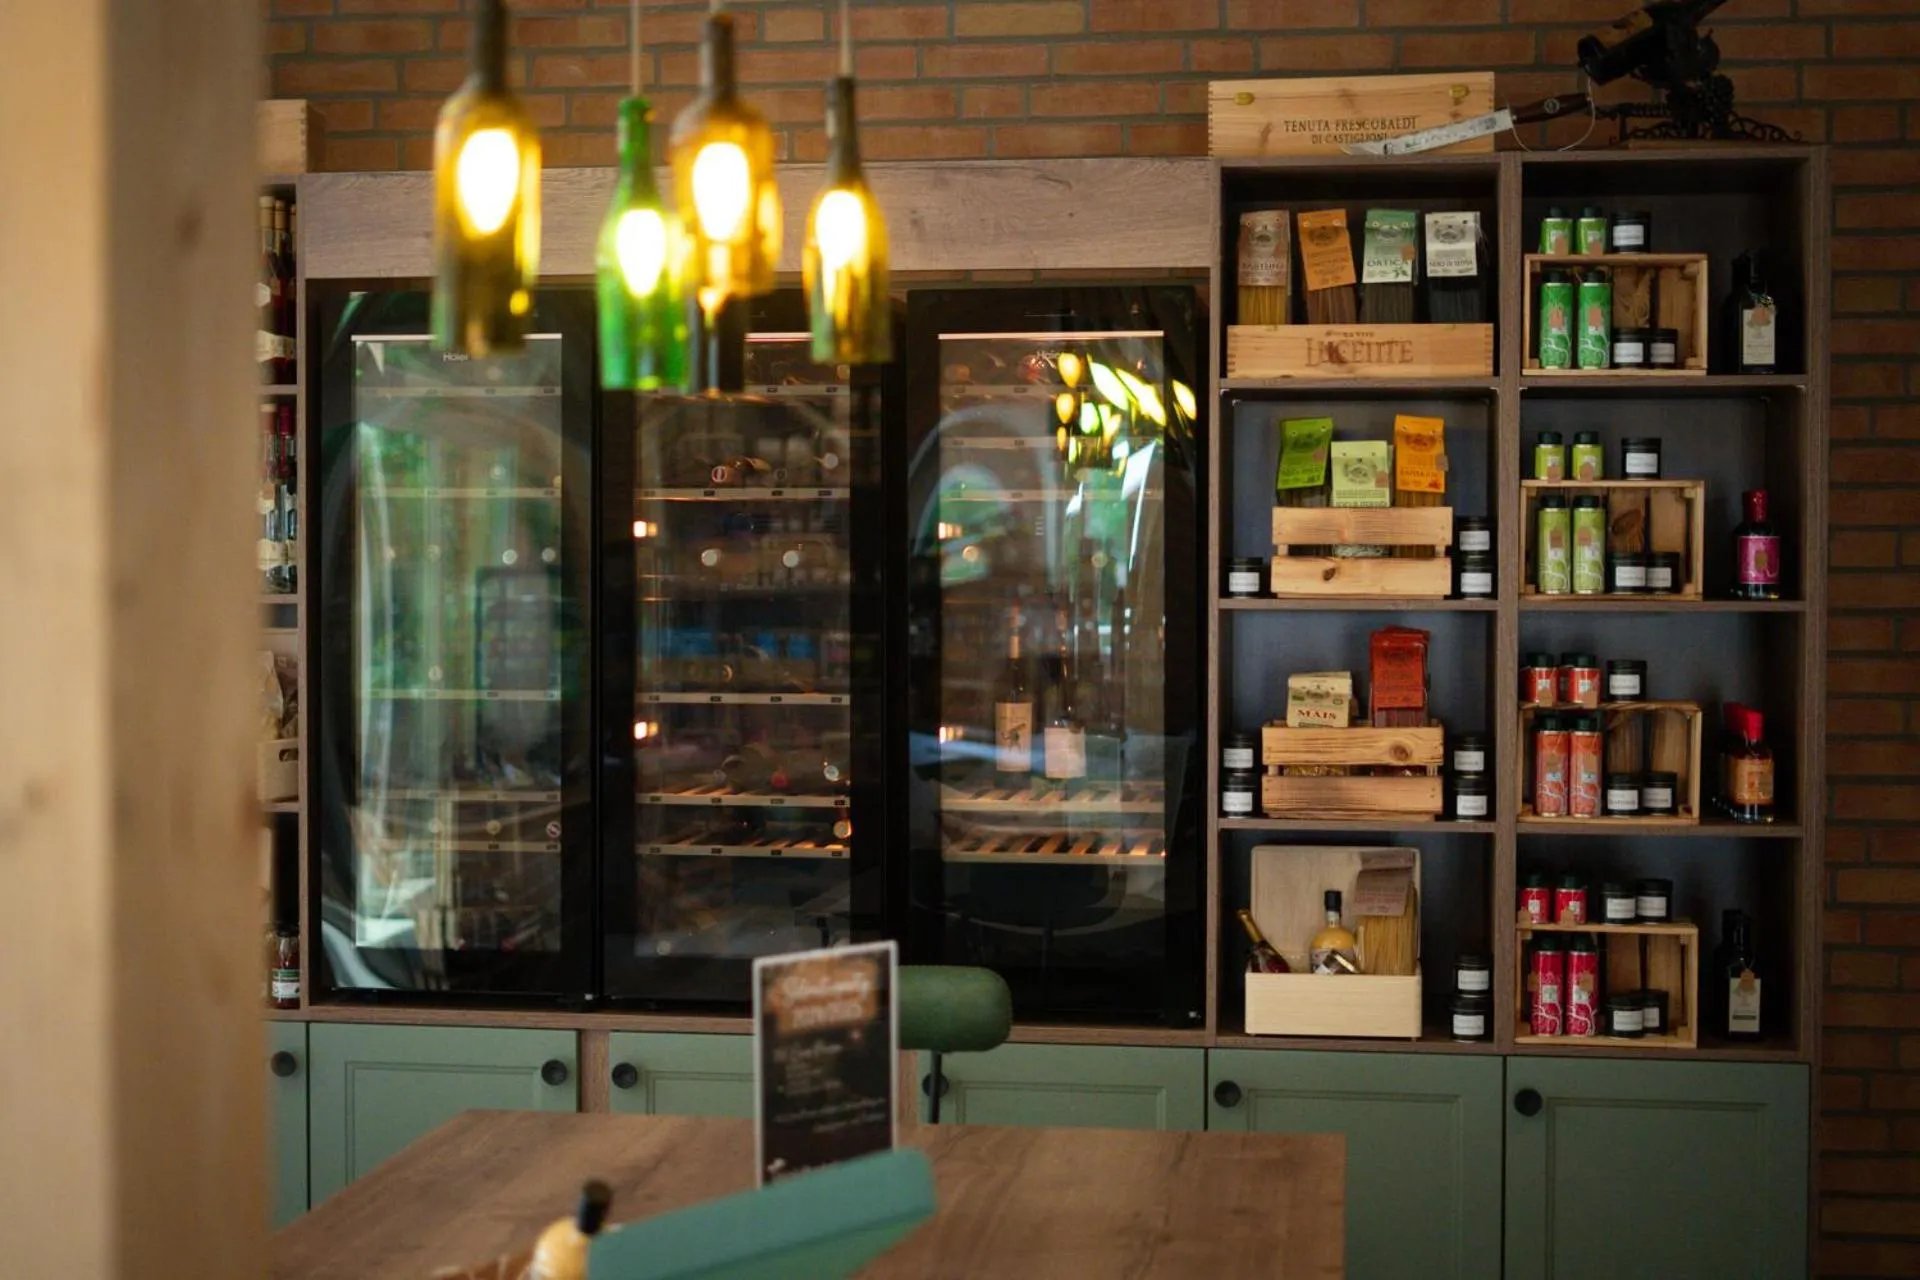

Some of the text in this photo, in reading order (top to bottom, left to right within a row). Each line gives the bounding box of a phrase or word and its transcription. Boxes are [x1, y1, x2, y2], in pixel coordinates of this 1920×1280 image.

[1284, 116, 1417, 132] TENUTA FRESCOBALDI
[1311, 134, 1322, 144] DI
[1297, 709, 1337, 720] MAIS
